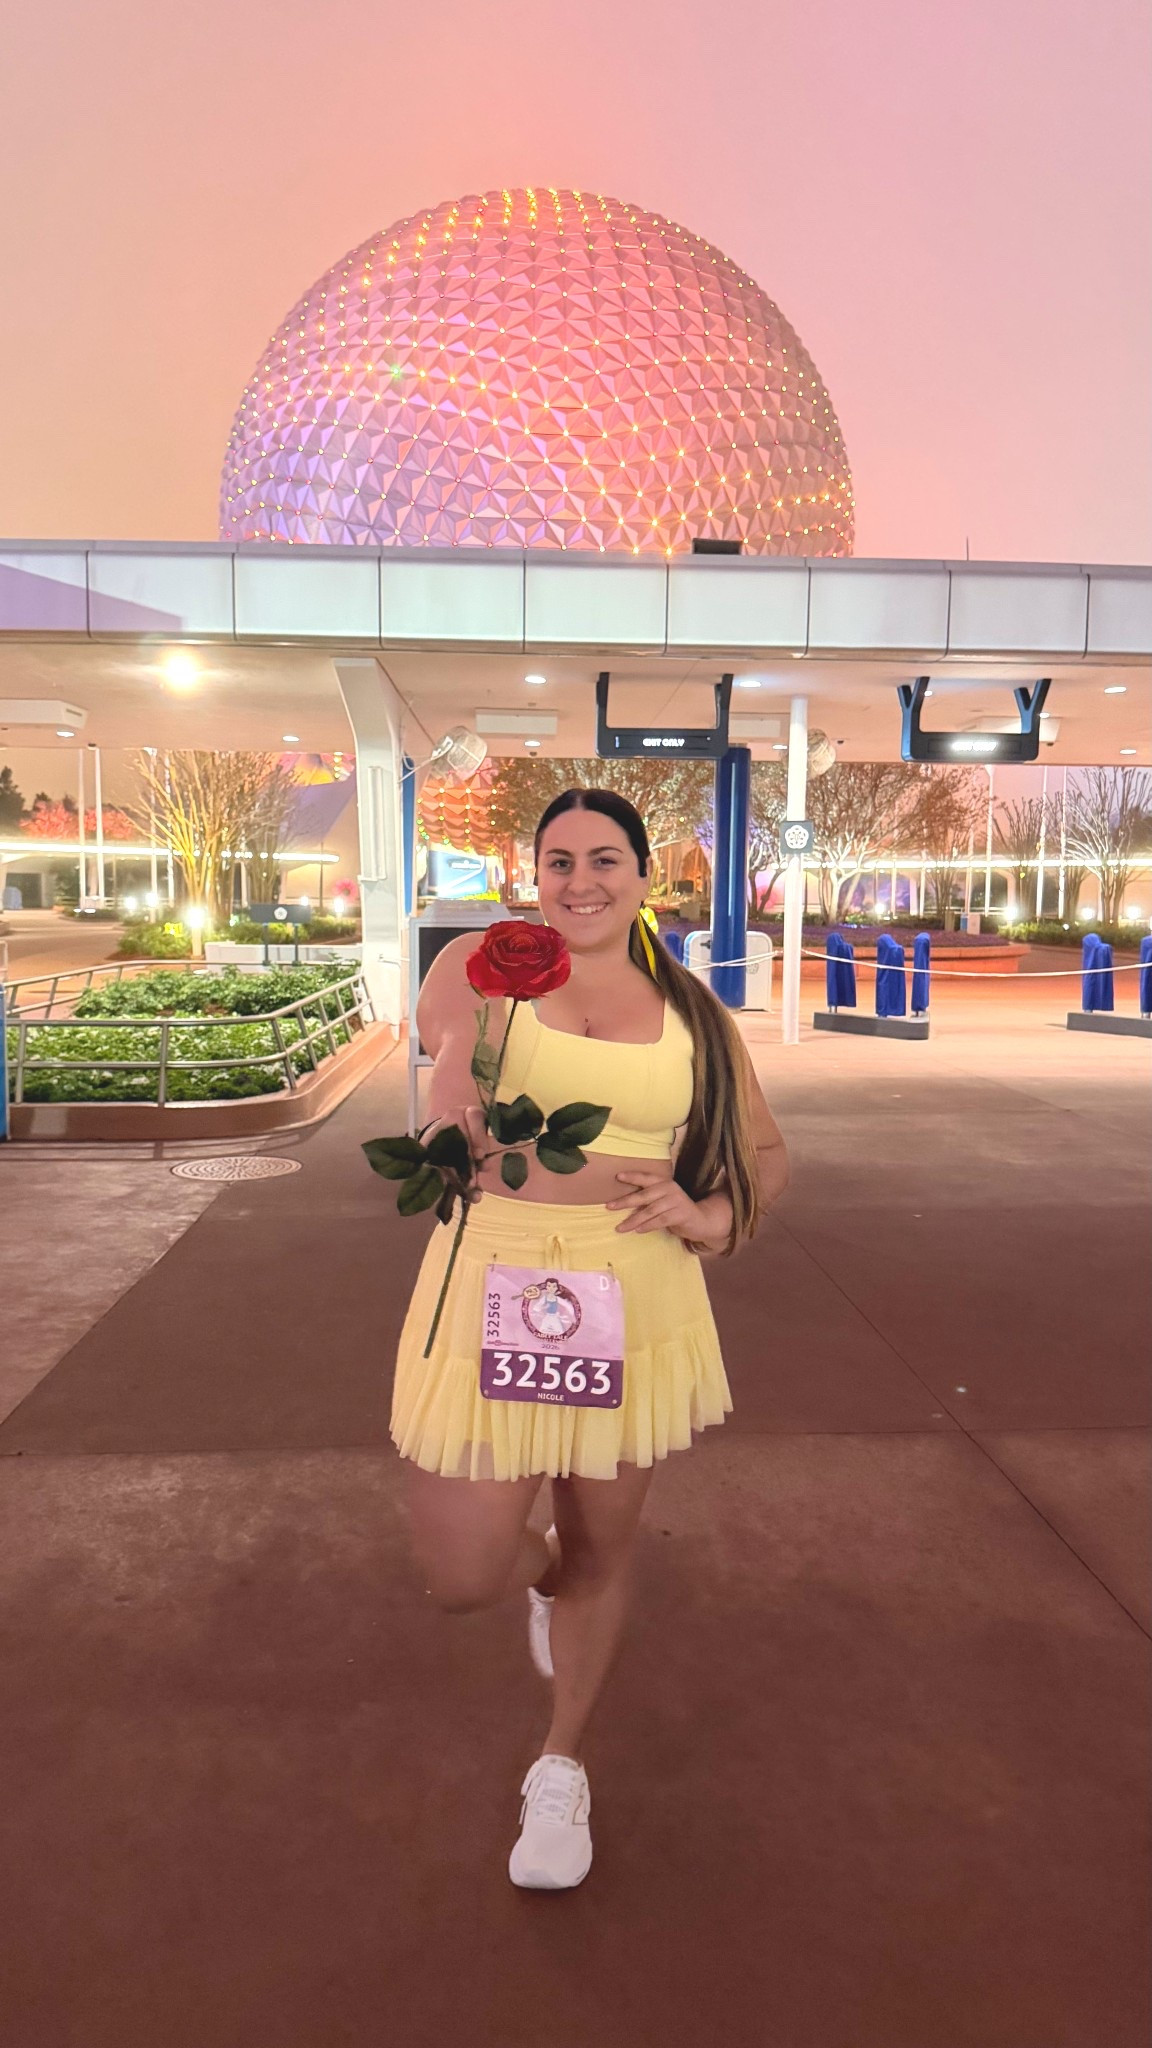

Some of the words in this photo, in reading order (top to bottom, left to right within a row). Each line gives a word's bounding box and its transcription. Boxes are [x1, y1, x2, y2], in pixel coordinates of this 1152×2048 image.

[599, 1276, 610, 1291] D
[487, 1293, 501, 1337] 32563
[492, 1352, 611, 1395] 32563
[537, 1392, 565, 1402] NICOLE
